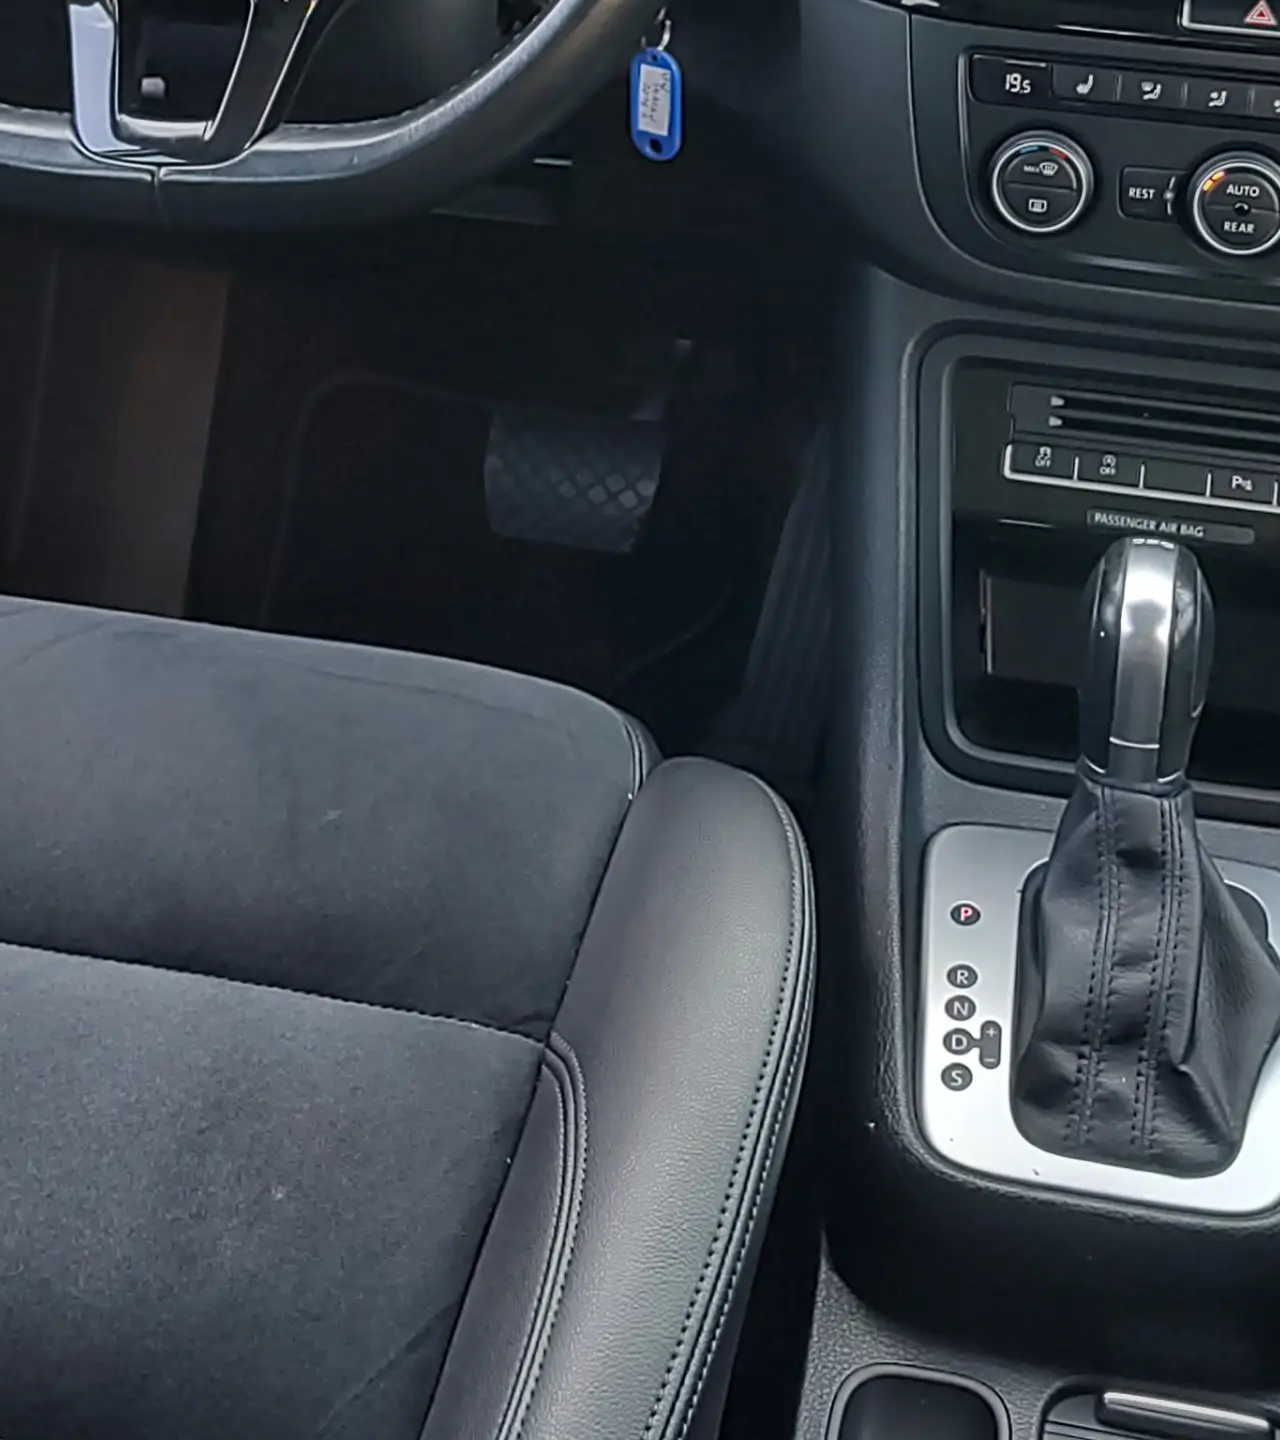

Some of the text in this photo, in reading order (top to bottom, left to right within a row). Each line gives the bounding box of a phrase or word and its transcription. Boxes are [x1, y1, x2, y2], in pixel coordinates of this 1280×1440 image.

[1005, 73, 1032, 94] 19.5
[1128, 188, 1155, 200] REST
[1226, 183, 1260, 197] AUTO
[1224, 221, 1255, 234] REAR
[1094, 512, 1157, 532] PASSENGER
[960, 906, 973, 921] P
[956, 970, 968, 984] R
[953, 1001, 968, 1016] N
[951, 1034, 967, 1050] D
[950, 1070, 963, 1086] S
